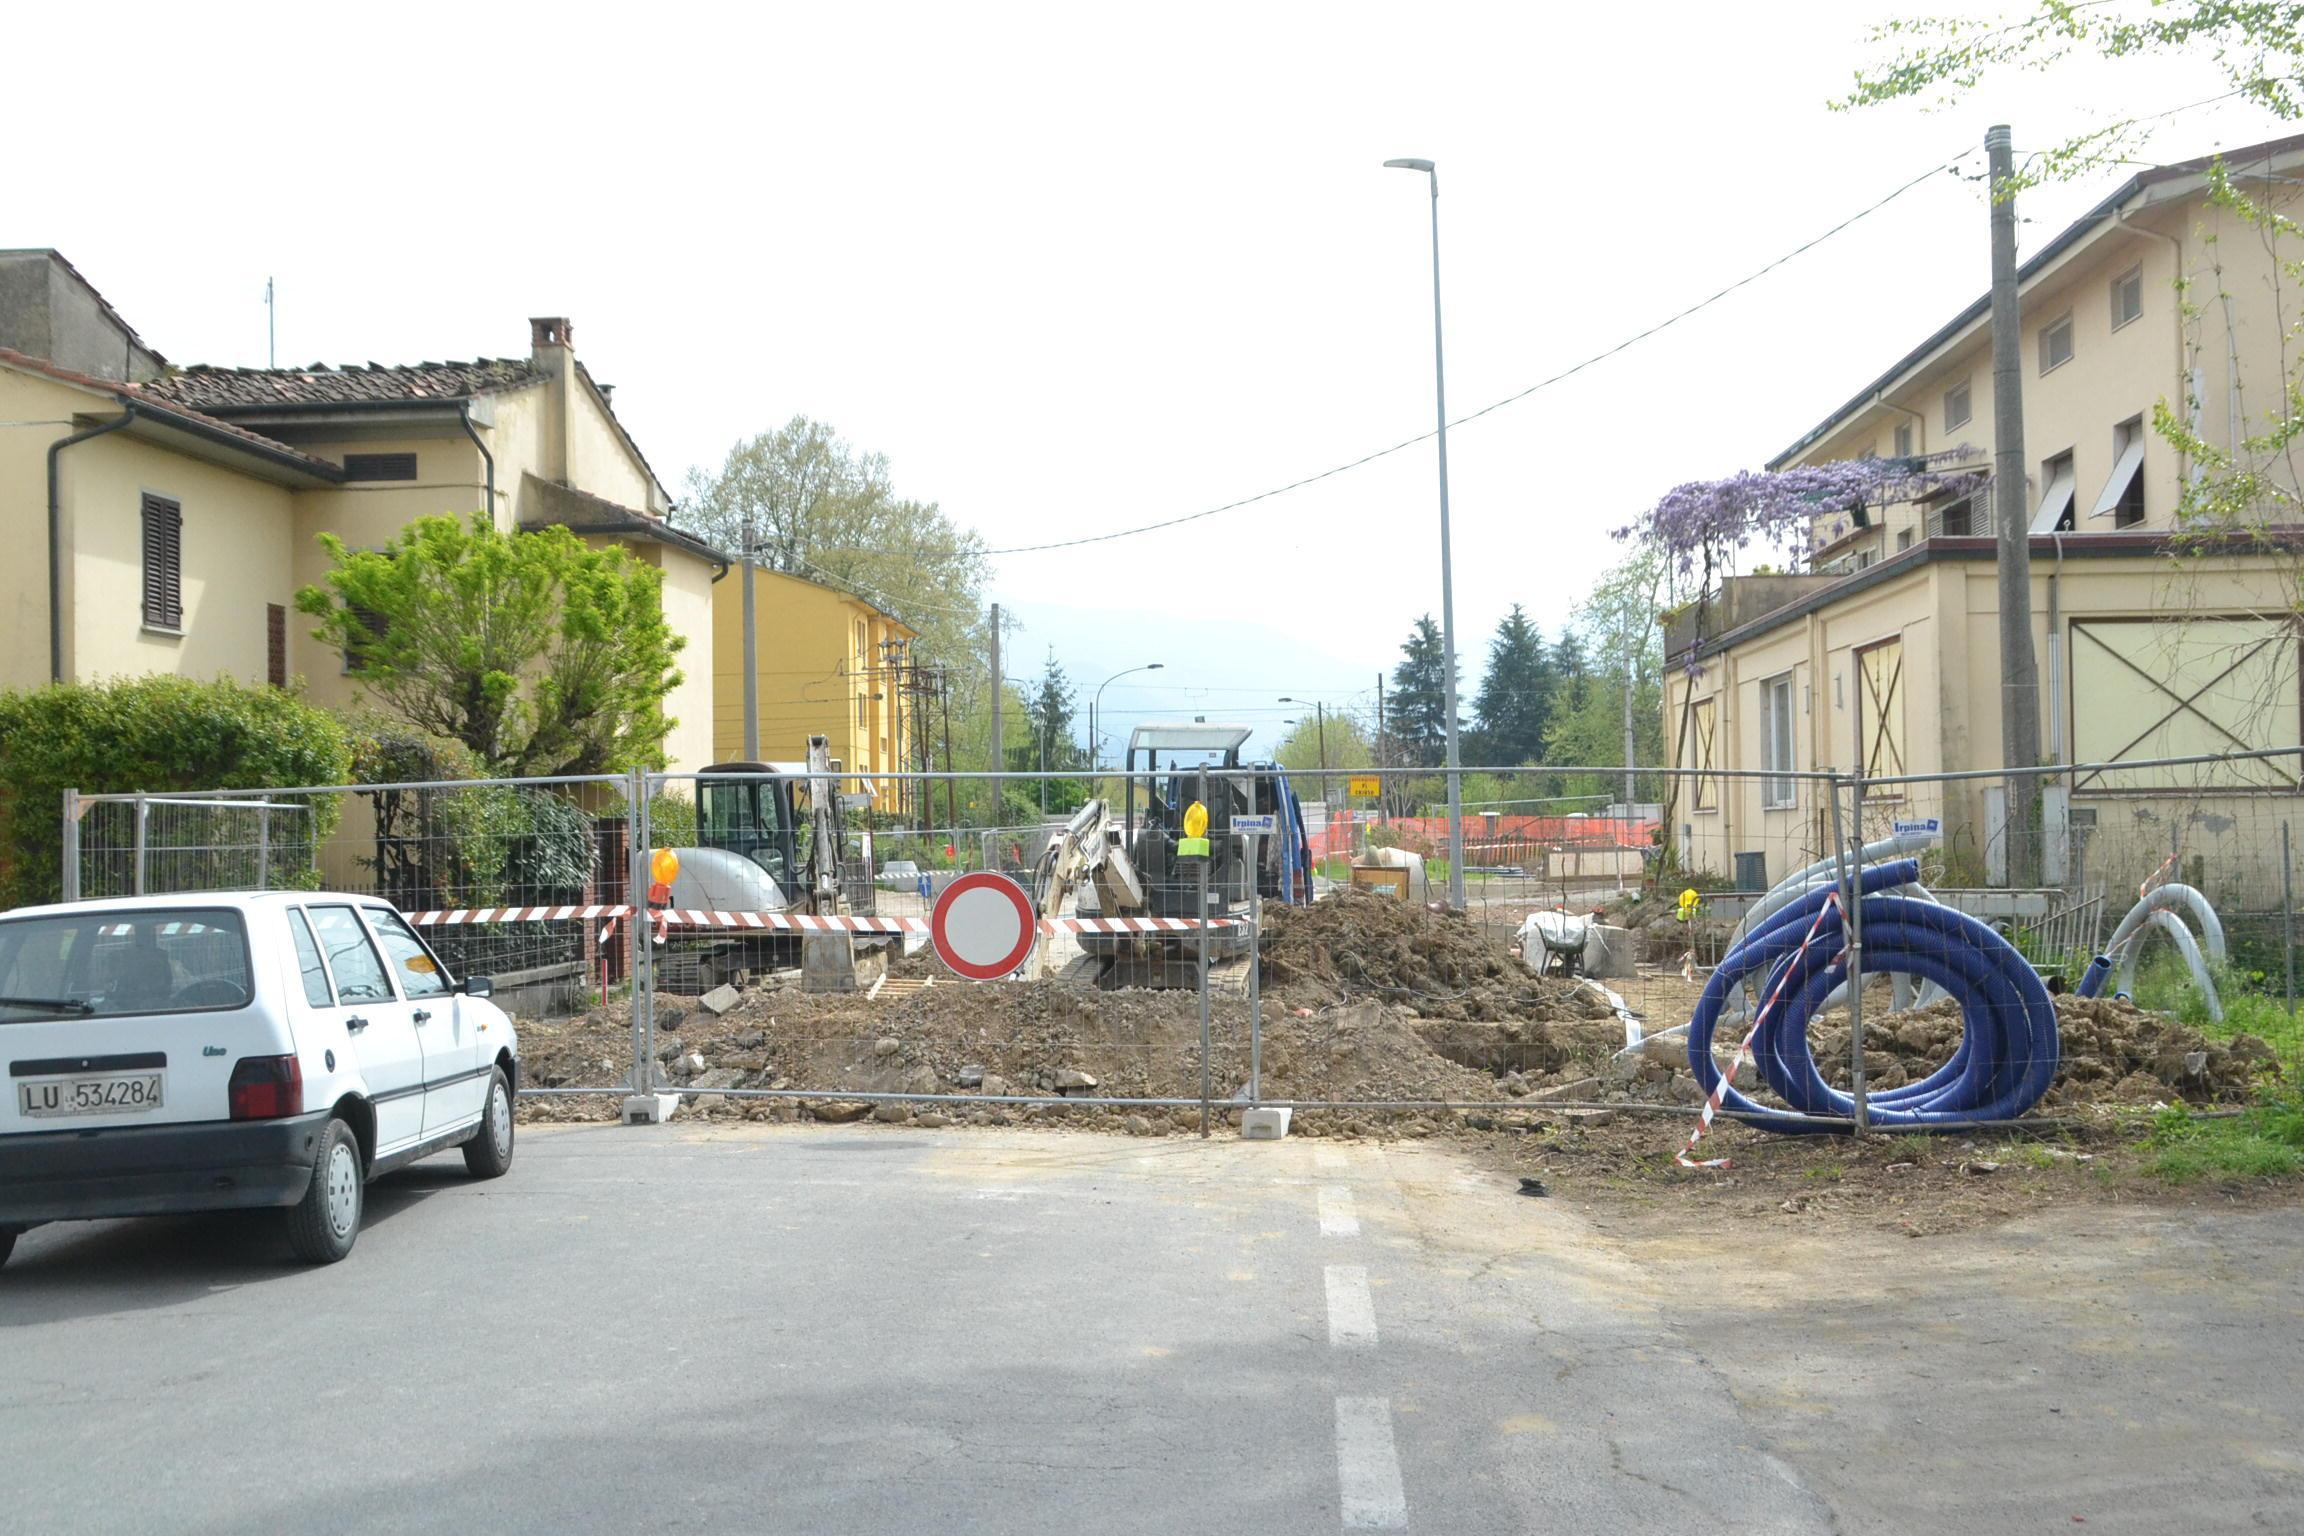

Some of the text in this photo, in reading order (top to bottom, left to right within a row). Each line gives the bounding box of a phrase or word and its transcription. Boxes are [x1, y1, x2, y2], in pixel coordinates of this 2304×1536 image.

[1233, 817, 1261, 828] Irpina
[1894, 822, 1926, 832] Irpina
[202, 1045, 227, 1057] Uno
[27, 1086, 59, 1110] LU
[76, 1080, 158, 1107] 534284
